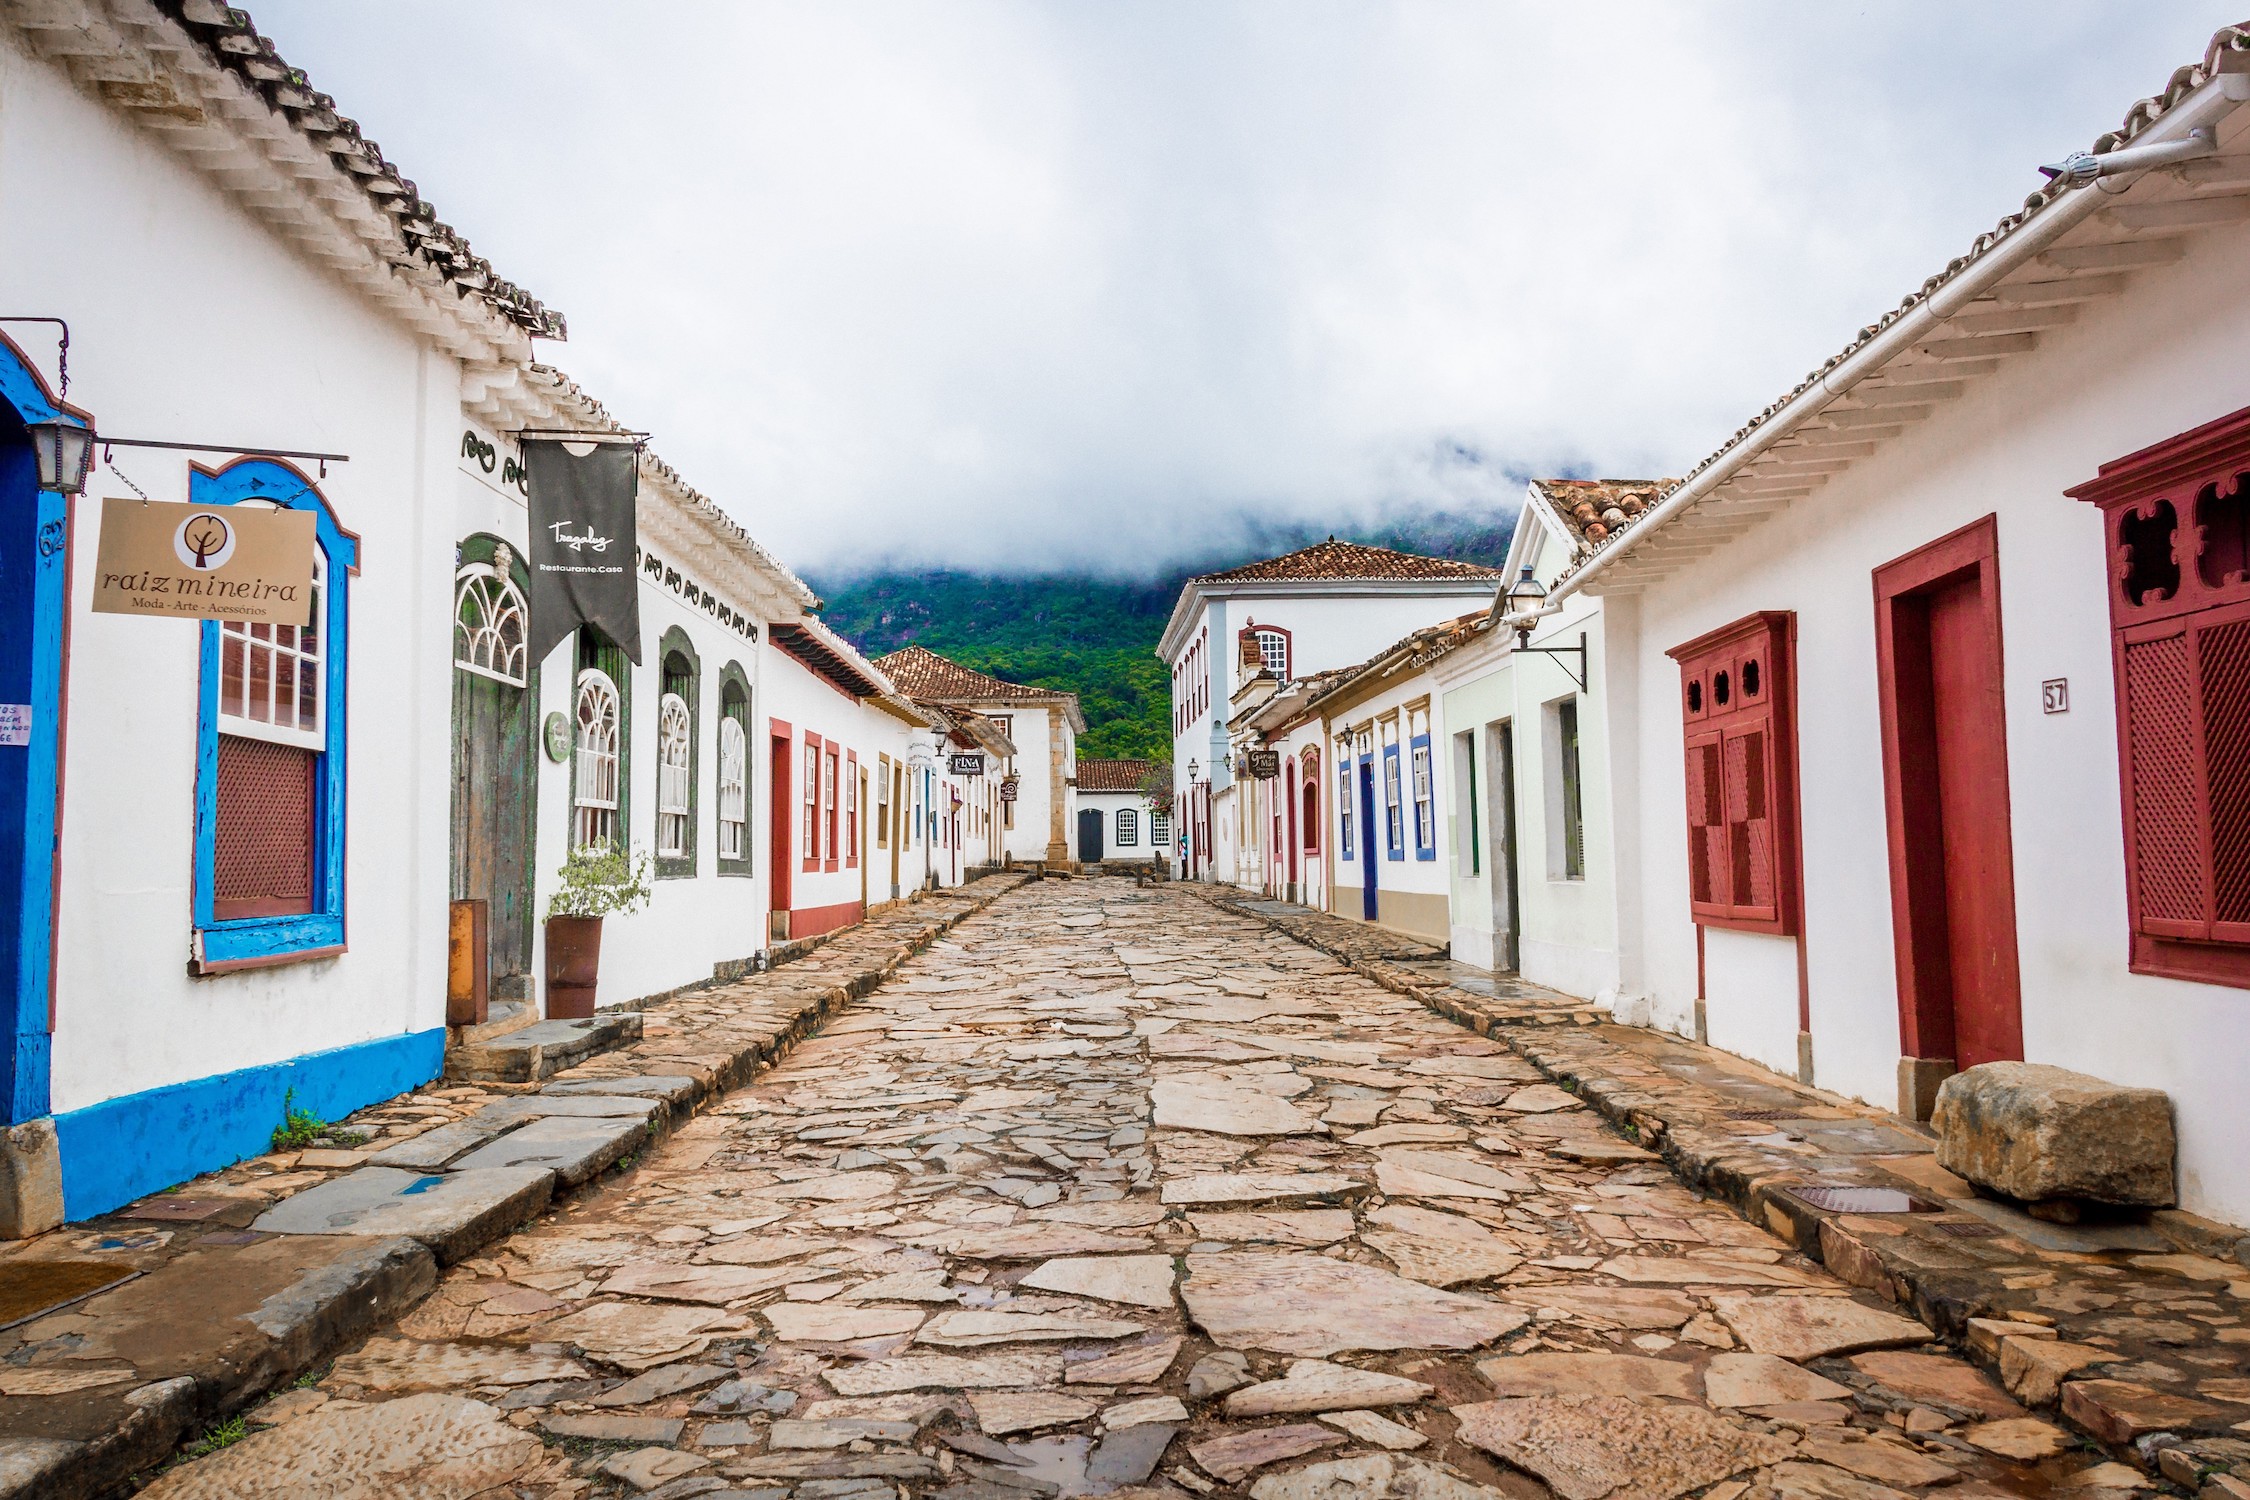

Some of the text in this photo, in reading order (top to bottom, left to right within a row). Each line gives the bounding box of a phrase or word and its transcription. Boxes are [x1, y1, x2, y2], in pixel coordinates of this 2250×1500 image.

[548, 521, 614, 552] Tragaluz
[103, 571, 298, 602] raiz mineira
[132, 597, 164, 609] Moda
[175, 601, 199, 611] Arte
[209, 603, 267, 615] Acessórios
[2045, 684, 2064, 709] 57
[955, 757, 980, 767] FINA
